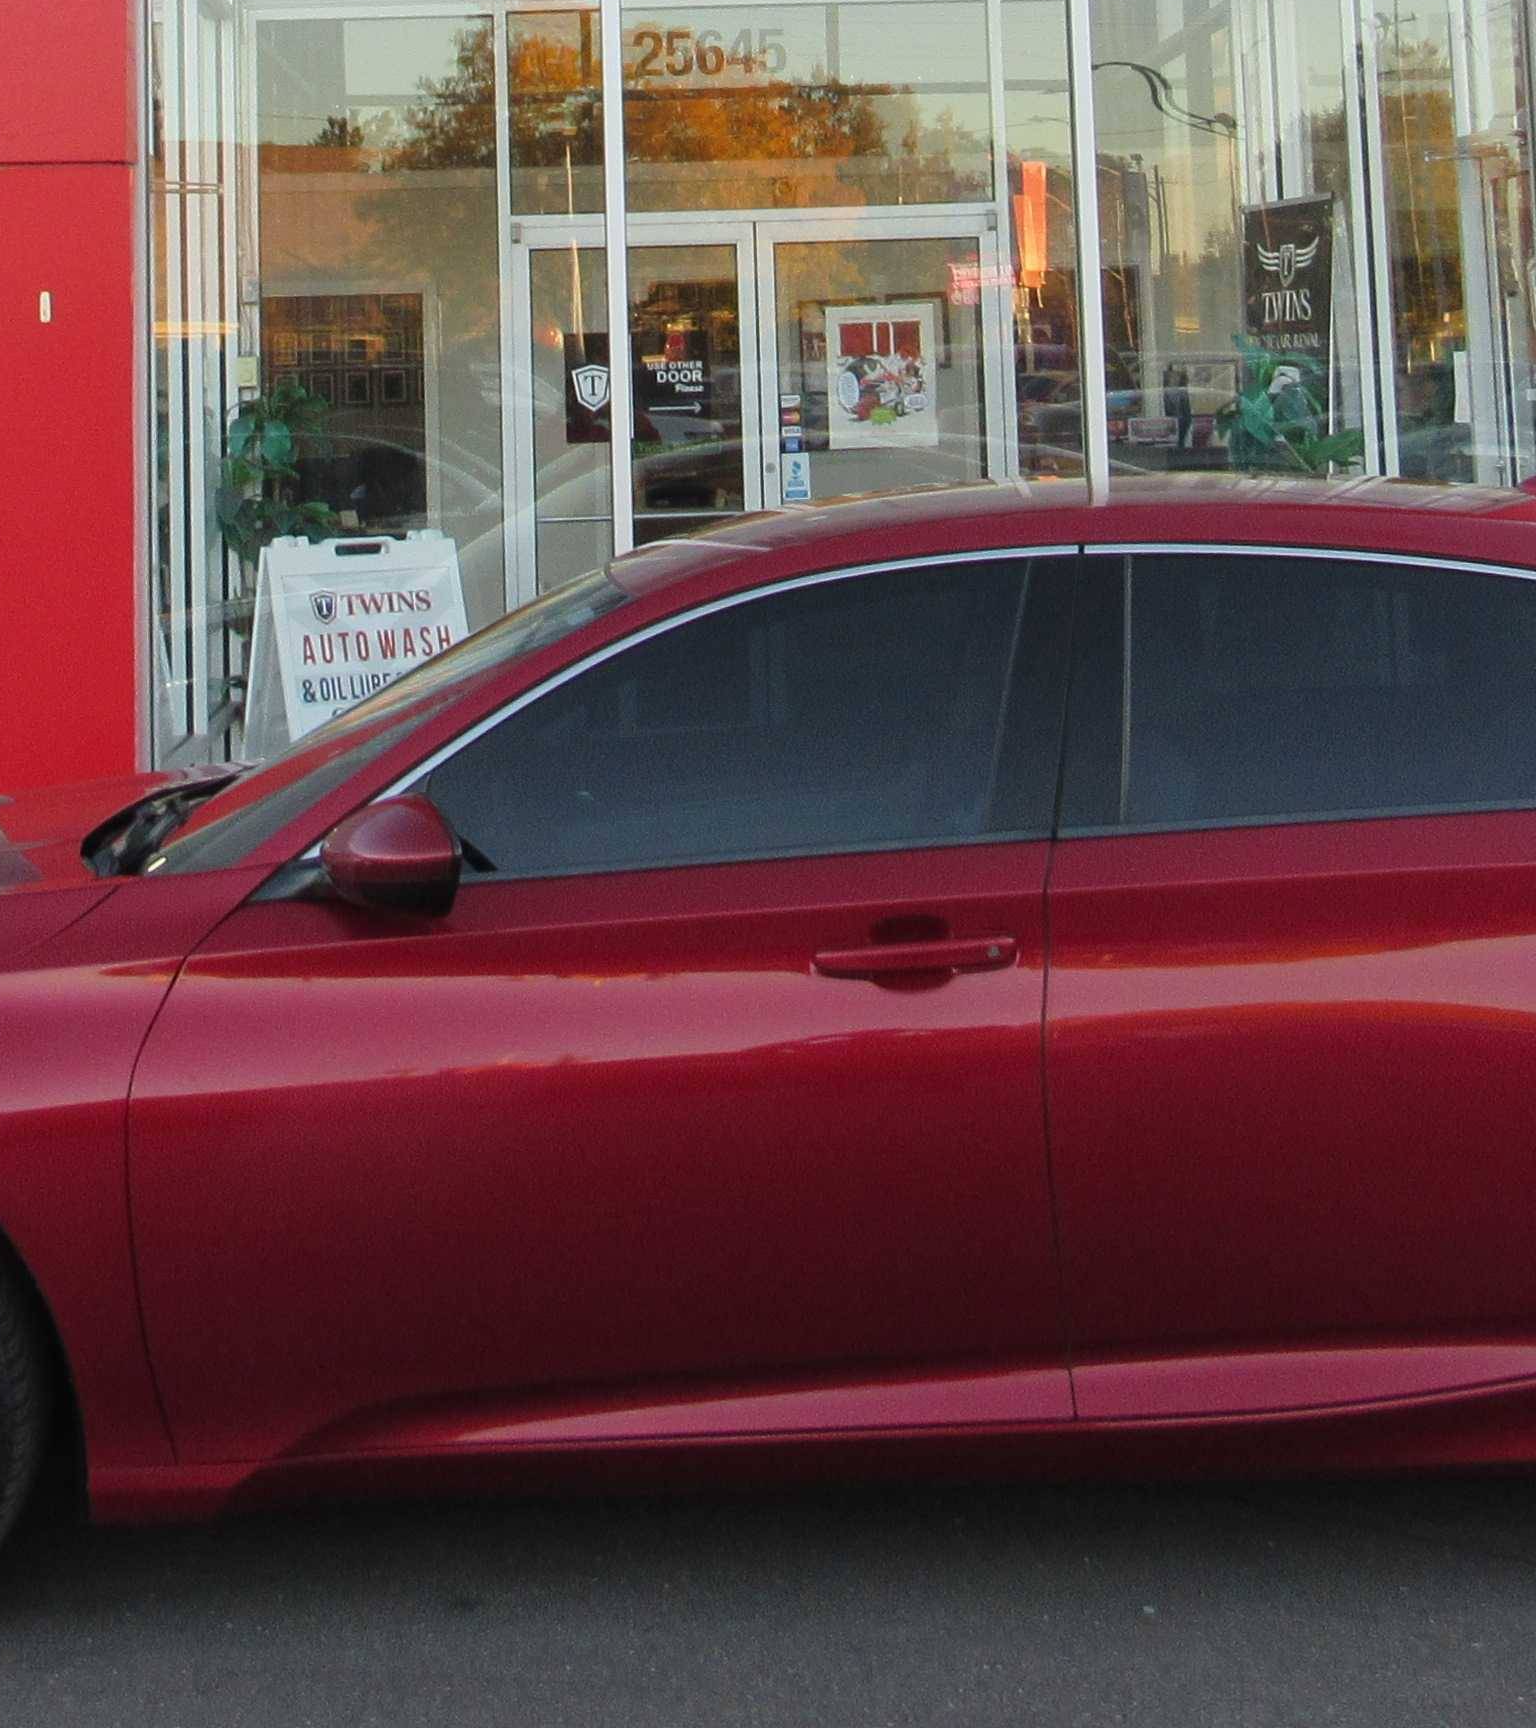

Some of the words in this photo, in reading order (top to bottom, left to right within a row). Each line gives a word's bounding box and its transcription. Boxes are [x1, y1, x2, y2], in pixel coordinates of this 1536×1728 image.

[633, 29, 787, 76] 25645
[1263, 289, 1312, 323] TWINS
[647, 362, 665, 371] USE
[668, 360, 703, 370] OTHER
[656, 370, 703, 383] DOOR
[584, 375, 603, 396] T
[340, 589, 432, 616] TWINS
[302, 630, 370, 666] AUTO
[376, 625, 452, 659] WASH
[302, 679, 317, 703] &
[319, 675, 348, 702] OIL
